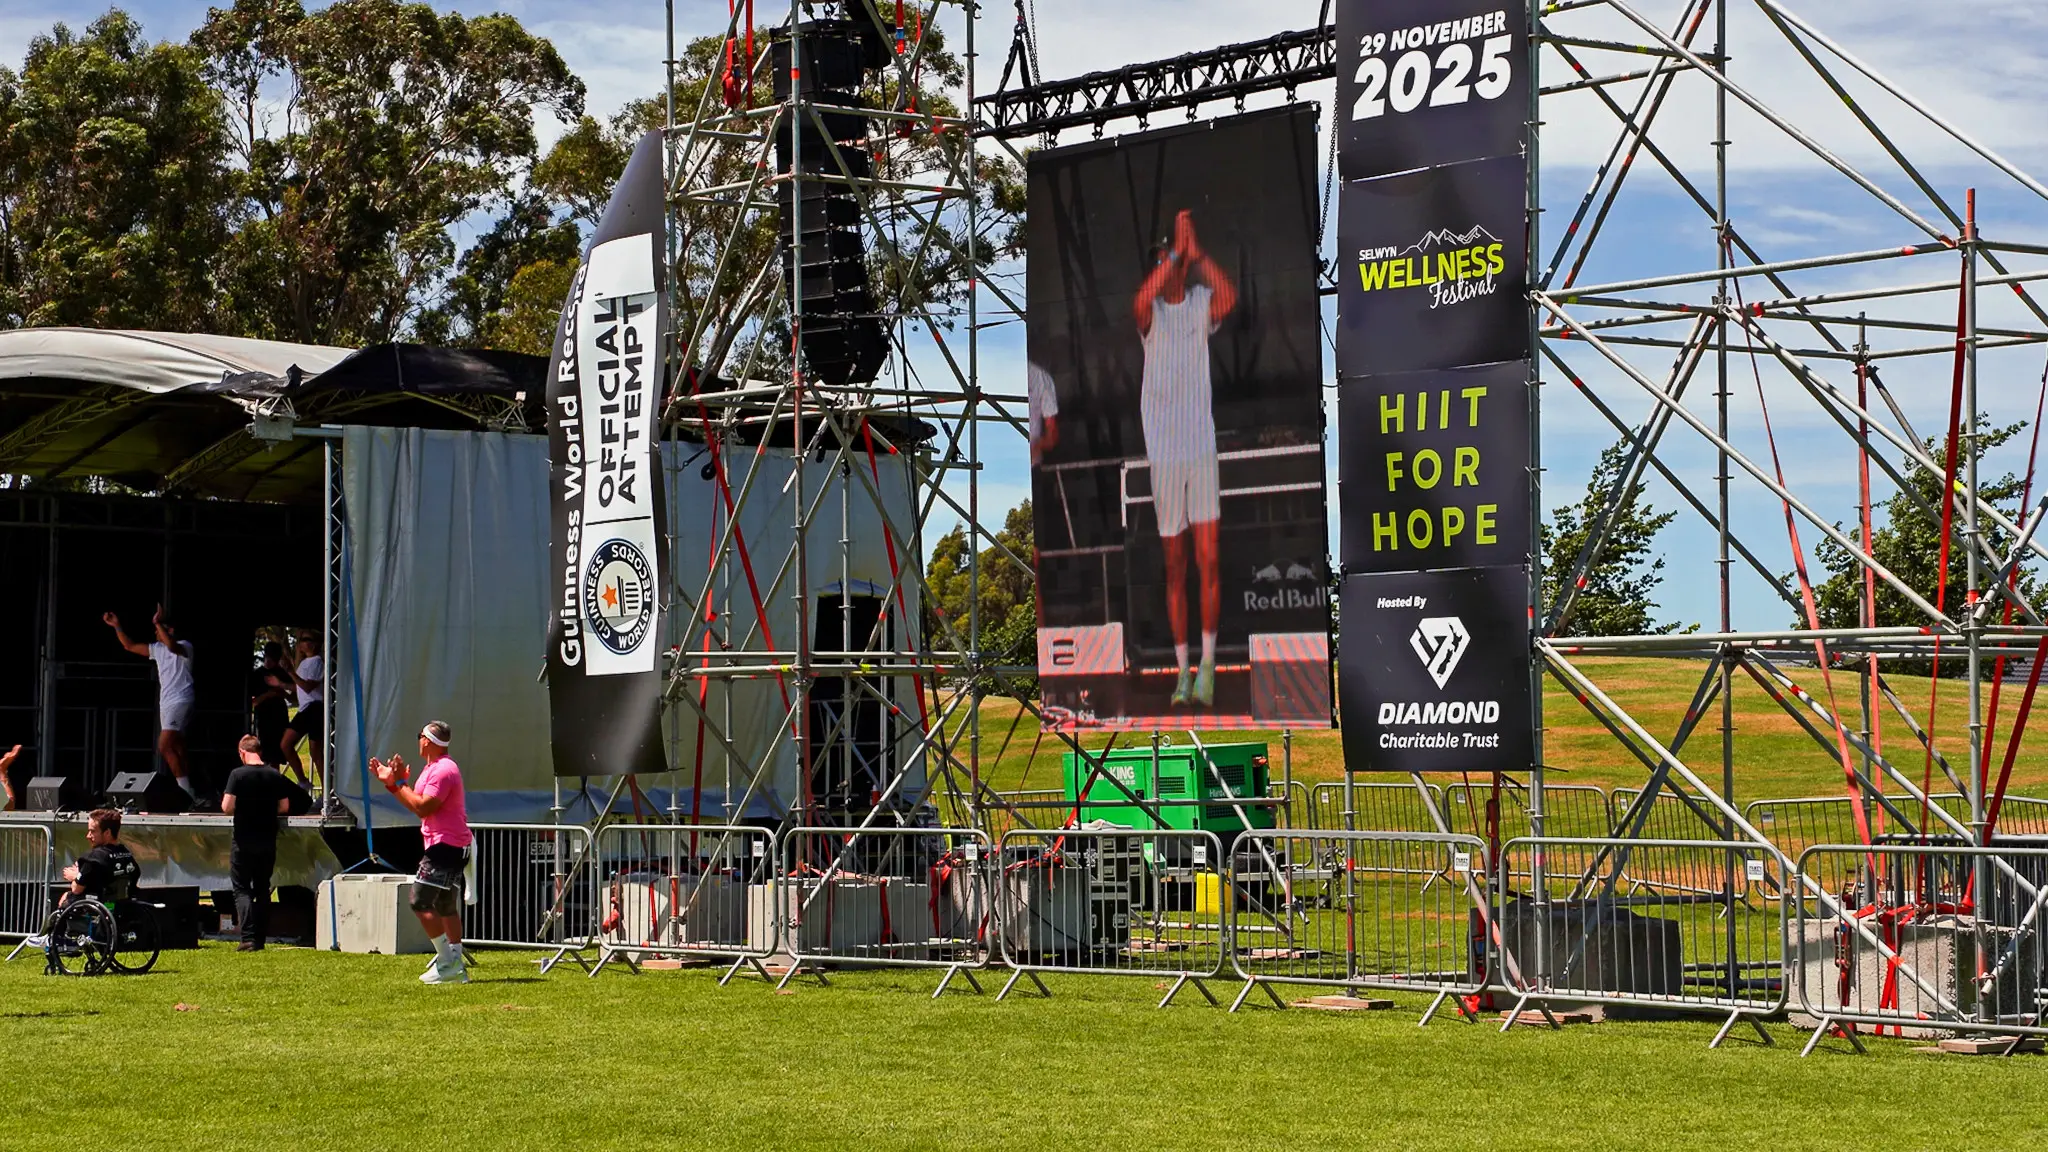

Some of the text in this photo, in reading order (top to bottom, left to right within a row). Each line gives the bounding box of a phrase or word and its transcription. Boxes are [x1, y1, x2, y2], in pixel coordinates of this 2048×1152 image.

[1359, 10, 1506, 57] 29 NOVEMBER
[1351, 33, 1512, 121] 2025
[1358, 245, 1398, 261] SELWYN
[1358, 242, 1505, 292] WELLNESS
[1428, 262, 1497, 310] Festival
[593, 297, 620, 508] OFFICIAL
[617, 295, 644, 505] ATTEMPT
[1380, 386, 1487, 434] HIIT
[557, 395, 582, 502] World
[1386, 446, 1480, 492] FOR
[1372, 504, 1498, 551] HOPE
[560, 509, 581, 667] Guinness
[587, 554, 611, 639] GUINNESS
[611, 544, 652, 649] WORLD RECORDS
[1243, 586, 1326, 611] Red Bull
[1376, 595, 1427, 610] Hosted By
[1377, 700, 1500, 725] DIAMOND
[1379, 732, 1500, 749] Charitable Trust
